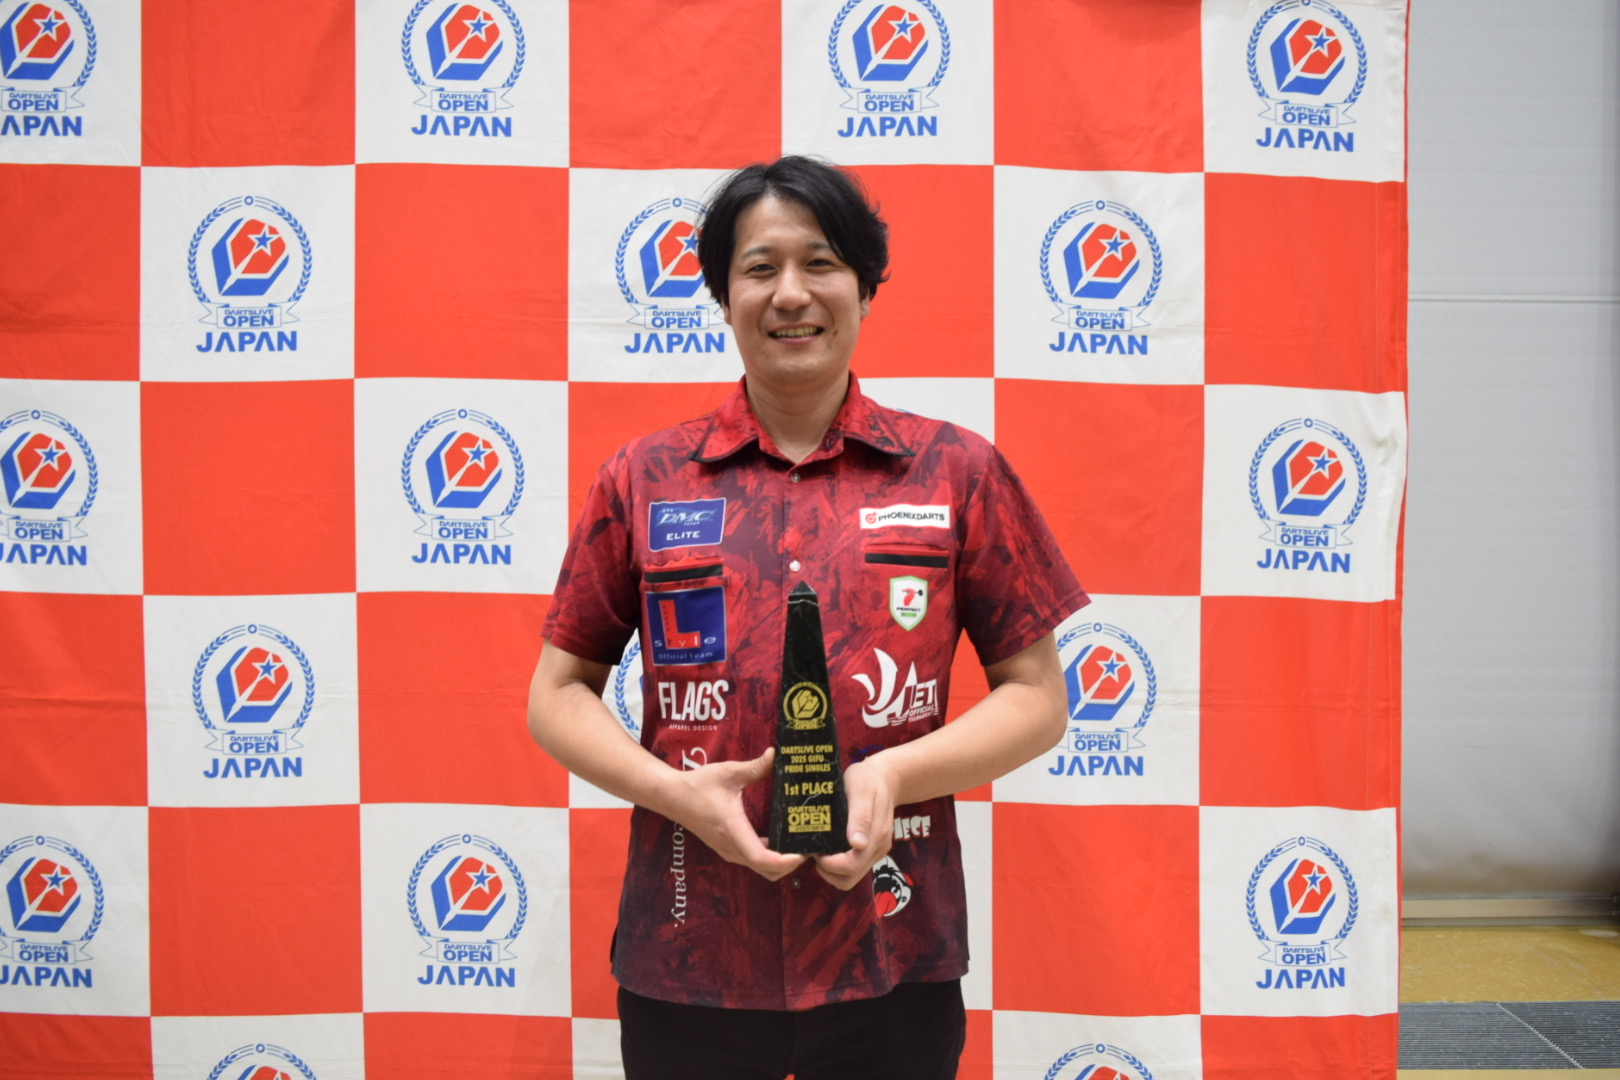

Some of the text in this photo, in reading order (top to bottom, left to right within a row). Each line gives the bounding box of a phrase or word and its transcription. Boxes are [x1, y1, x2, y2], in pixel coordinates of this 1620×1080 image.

[9, 92, 59, 100] DARTSLIVE
[8, 98, 59, 111] OPEN
[439, 98, 489, 112] OPEN
[865, 99, 915, 112] OPEN
[1283, 105, 1331, 115] DARTSLIVE
[1, 115, 83, 137] APAN
[412, 115, 512, 137] JAPAN
[1282, 112, 1331, 126] OPEN
[838, 116, 938, 137] JAPAN
[1257, 128, 1355, 152] JAPAN
[225, 308, 274, 316] DARTSLIVE
[224, 314, 275, 327] OPEN
[652, 315, 702, 329] OPEN
[1075, 315, 1125, 330] OPEN
[196, 331, 298, 353] JAPAN
[625, 332, 725, 354] JAPAN
[1049, 331, 1148, 356] JAPAN
[878, 510, 945, 522] PHOENIXDARTS
[16, 521, 63, 529] DARTSLIVE
[1281, 527, 1329, 535] DARTSLIVE
[15, 527, 63, 540] OPEN
[438, 526, 489, 540] OPEN
[666, 530, 701, 541] ELITE
[1280, 533, 1329, 547] OPEN
[412, 543, 512, 566] JAPAN
[1256, 549, 1351, 574] JAPAN
[657, 679, 729, 721] FLAGS
[668, 723, 690, 731] APPAREL
[230, 740, 280, 754] OPEN
[781, 744, 834, 754] DARTSLIVE OPEN
[1075, 738, 1122, 752] OPEN
[790, 755, 825, 763] 2025 GIFU
[1048, 755, 1144, 777] JAPAN
[203, 757, 303, 779] JAPAN
[784, 764, 831, 773] PRIDE SINGLES
[783, 781, 834, 795] 1st PLACE
[787, 804, 831, 813] DARTSLIVE
[788, 812, 831, 826] OPEN
[892, 815, 931, 841] IECE
[20, 943, 68, 952] DARTSLIVE
[19, 950, 69, 963] OPEN
[444, 948, 493, 963] OPEN
[1281, 951, 1326, 966] OPEN
[418, 965, 516, 987] JAPAN
[1256, 968, 1345, 989] JAPAN
